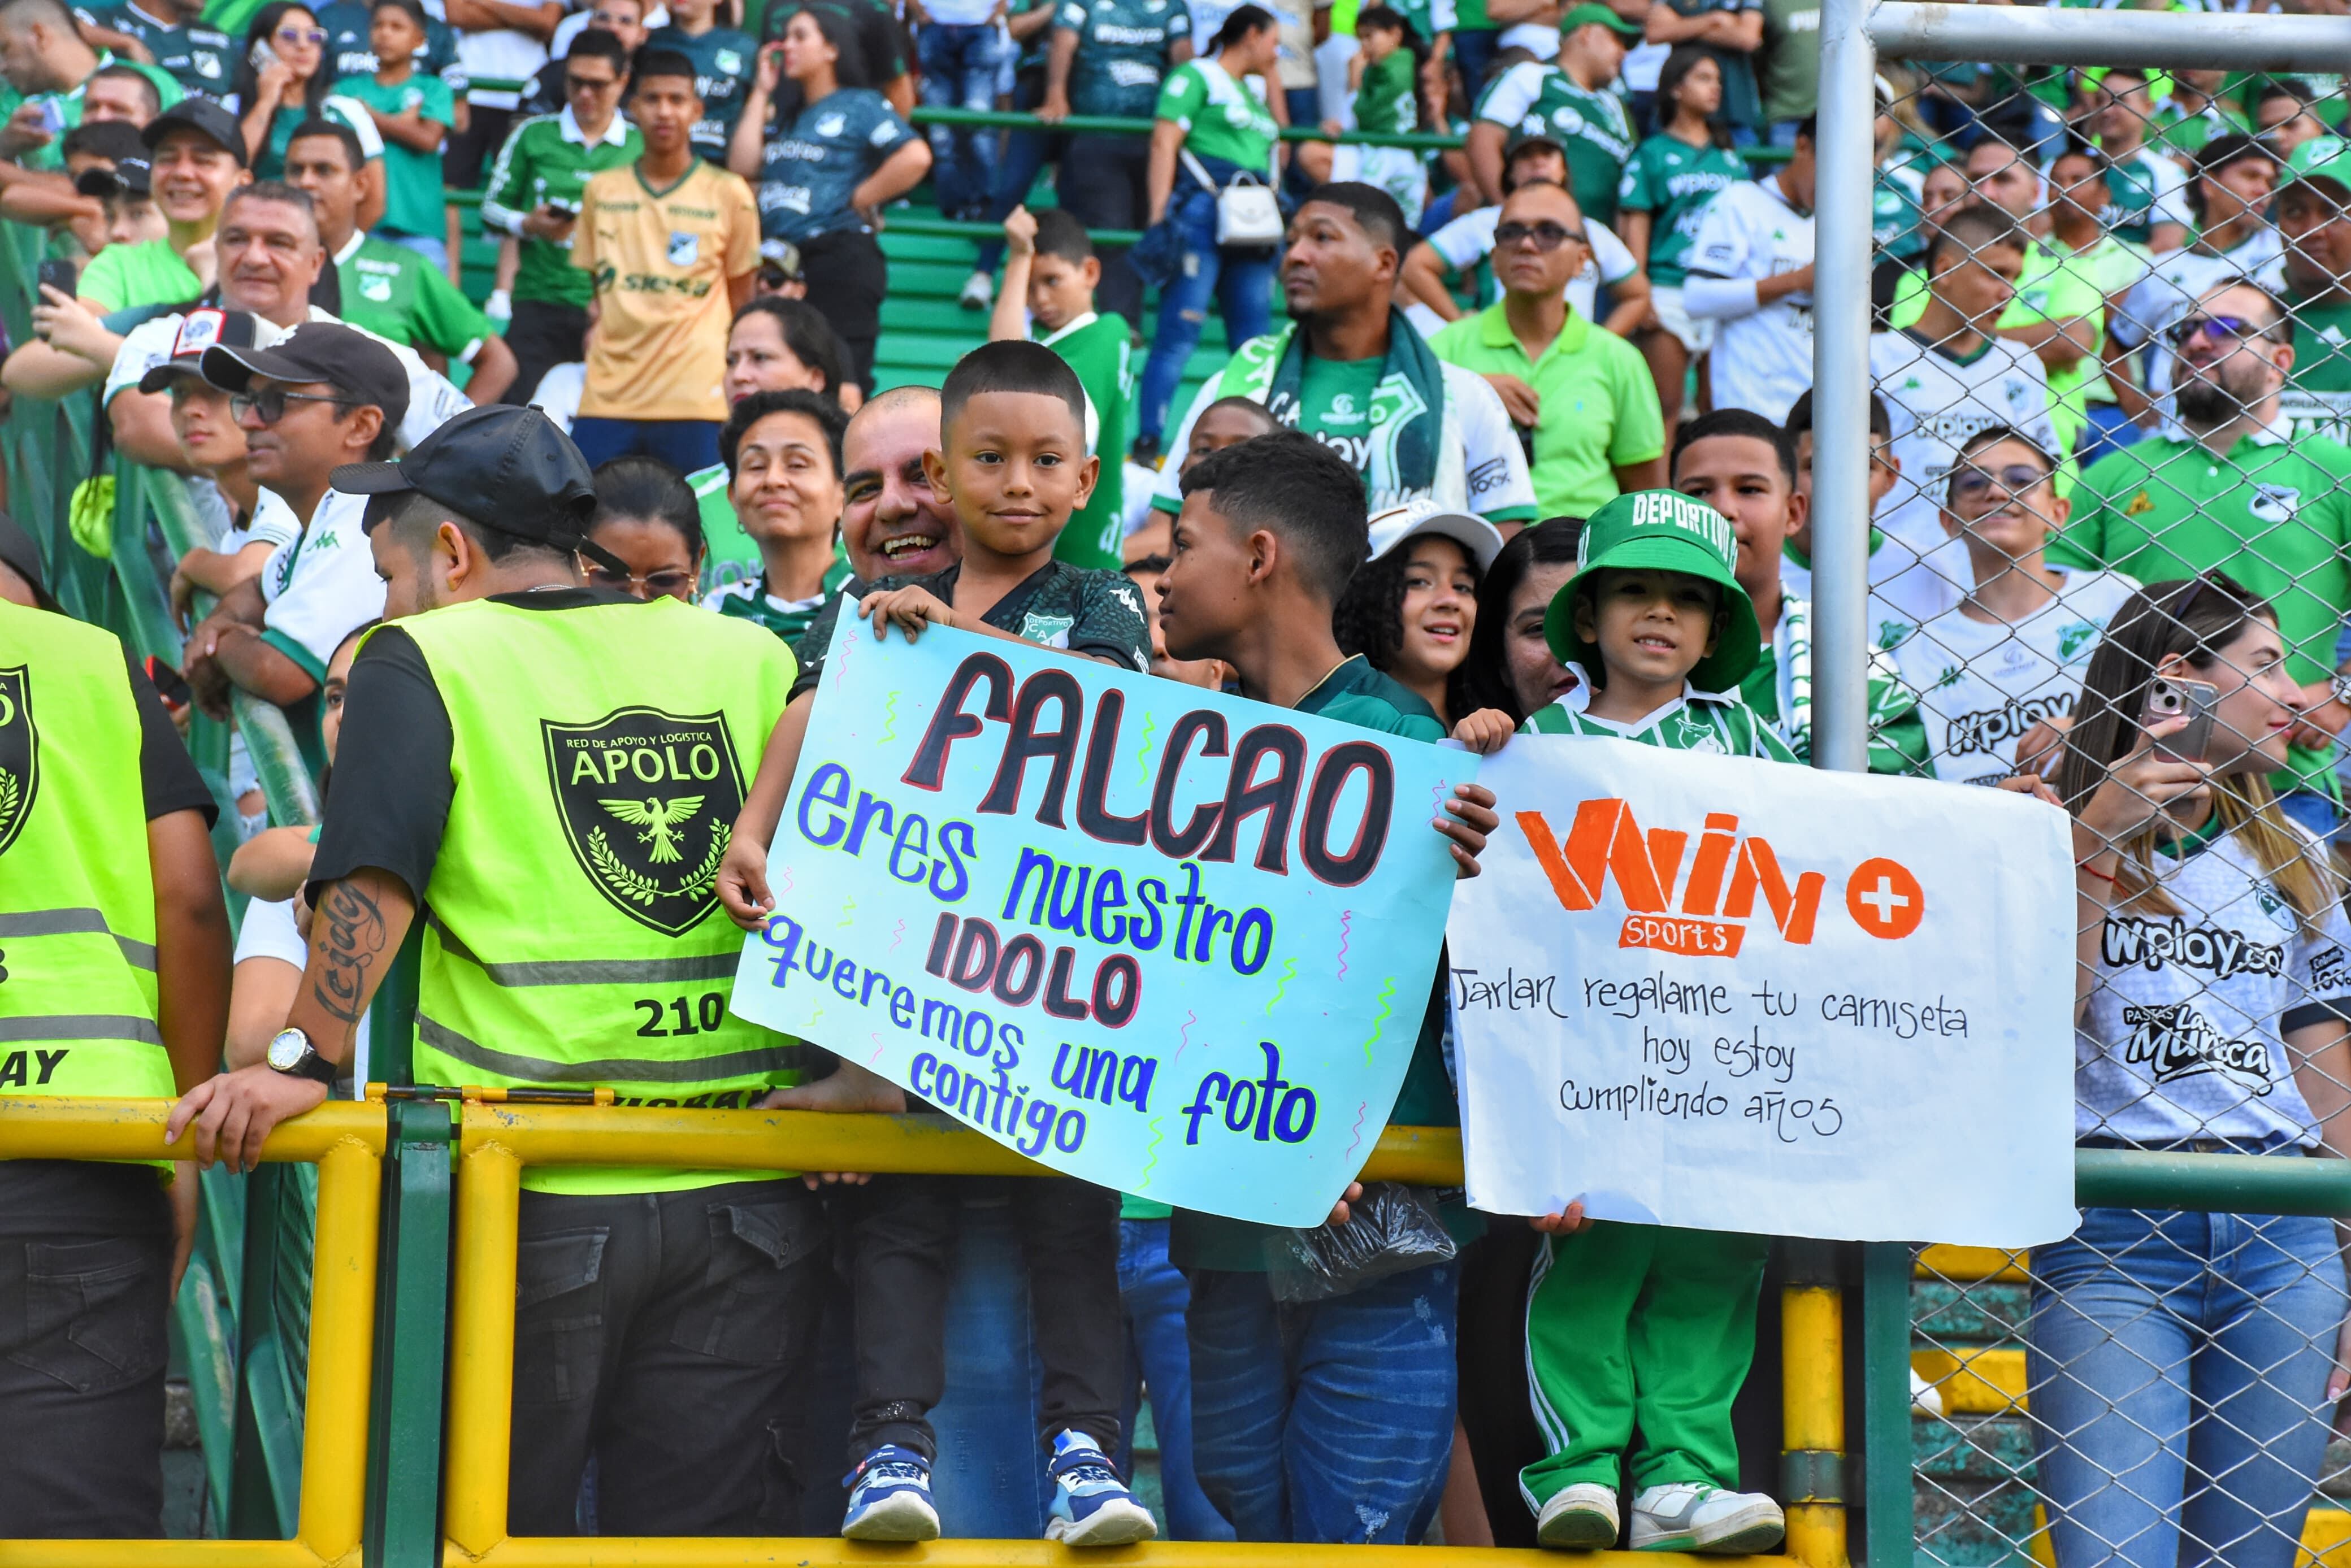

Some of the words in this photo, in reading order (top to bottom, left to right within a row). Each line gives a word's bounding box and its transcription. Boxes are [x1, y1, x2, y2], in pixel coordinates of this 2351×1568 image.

[1633, 493, 1730, 563] DEPORTIVO
[566, 739, 589, 748] RED
[592, 740, 607, 748] DE
[610, 736, 647, 748] APOYO
[649, 736, 656, 745] Y
[660, 732, 712, 744] LOGISTICA
[571, 744, 719, 785] APOLO
[900, 651, 1394, 888] FALCAO
[797, 761, 979, 903] eres
[1000, 846, 1274, 976] nuestro
[925, 911, 1142, 1029] IDOLO
[634, 992, 725, 1037] 210
[762, 913, 1025, 1070] queremos
[1051, 1042, 1159, 1113] una
[1181, 1041, 1318, 1145] foto
[1584, 971, 1732, 1018] regalame
[1752, 980, 1797, 1016] tu
[1821, 994, 1967, 1039] camiseta
[1644, 1026, 1690, 1074] hoy
[1715, 1025, 1794, 1083] estoy
[910, 1052, 1087, 1158] contigo
[1744, 1091, 1843, 1143] años
